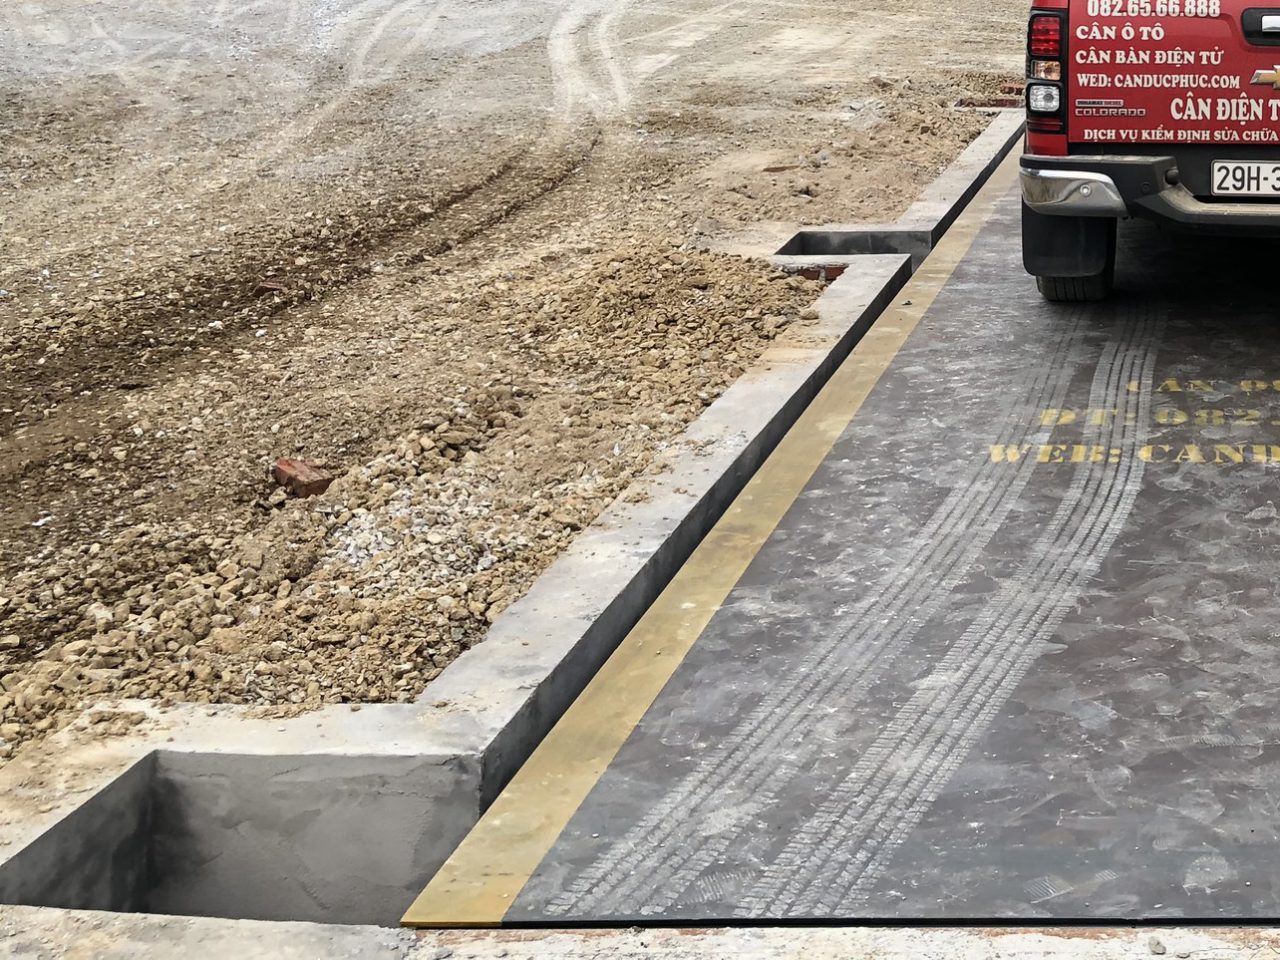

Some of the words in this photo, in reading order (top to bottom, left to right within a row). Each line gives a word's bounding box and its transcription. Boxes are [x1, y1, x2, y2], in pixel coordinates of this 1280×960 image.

[1075, 21, 1117, 40] CÂN
[1121, 22, 1135, 40] Ô
[1139, 22, 1165, 40] TÔ
[1075, 46, 1111, 64] CÂN
[1115, 46, 1150, 64] BÀN
[1154, 46, 1195, 67] ĐIỆN
[1199, 46, 1224, 65] TỬ
[1077, 73, 1112, 88] WED:
[1114, 73, 1240, 89] CANDUCPHUC.COM
[1075, 108, 1146, 116] COLORADO
[1170, 91, 1212, 121] CÂN
[1216, 91, 1263, 125] ĐIỆN
[1084, 129, 1116, 142] DỊCH
[1119, 129, 1138, 143] VỤ
[1141, 124, 1174, 140] KIỂM
[1177, 130, 1210, 143] ĐỊNH
[1213, 127, 1238, 141] SỬA
[1242, 128, 1279, 141] CHỮA
[989, 444, 1121, 464] WEB:
